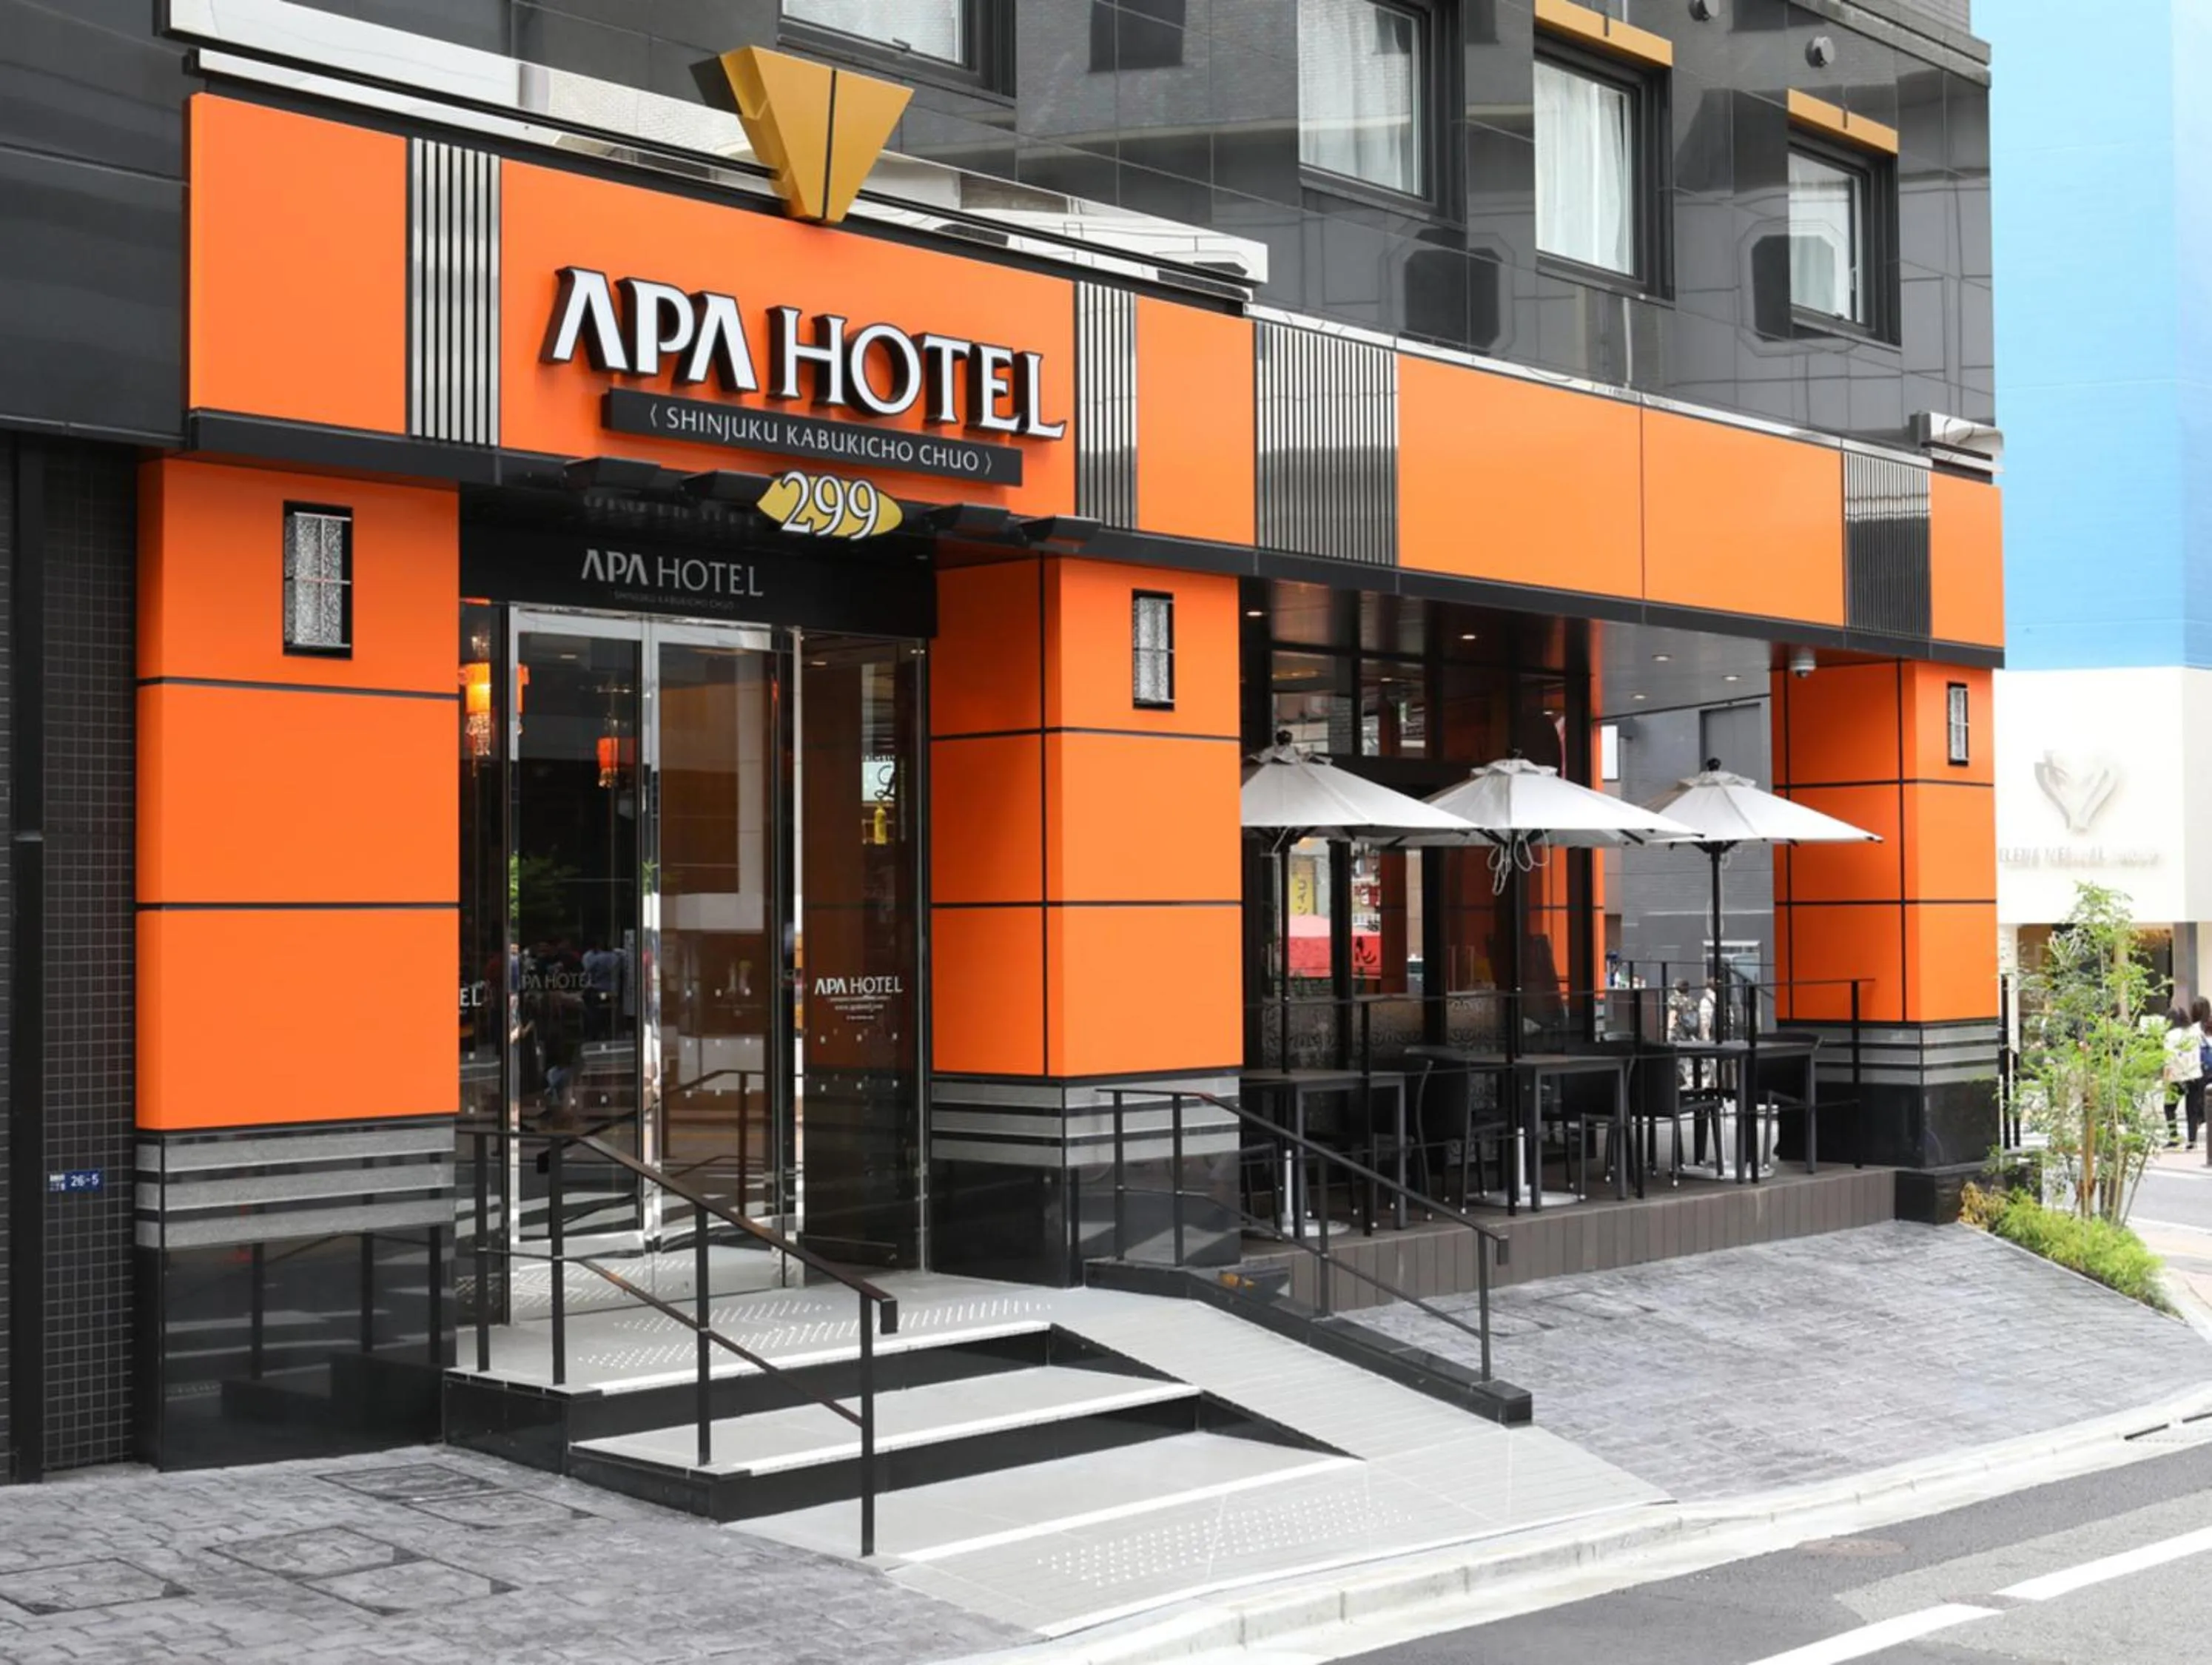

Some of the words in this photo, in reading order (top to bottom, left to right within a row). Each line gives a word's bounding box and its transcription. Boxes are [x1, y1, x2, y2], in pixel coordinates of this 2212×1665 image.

[551, 267, 758, 391] APA
[776, 305, 1067, 440] HOTEL
[666, 407, 779, 442] SHINJUKU
[786, 424, 914, 462] KABUKICHO
[918, 445, 979, 471] CHUO
[780, 470, 880, 542] 299
[581, 548, 649, 586] APA
[657, 556, 764, 596] HOTEL
[814, 978, 847, 995] APA
[850, 975, 904, 994] HOTEL
